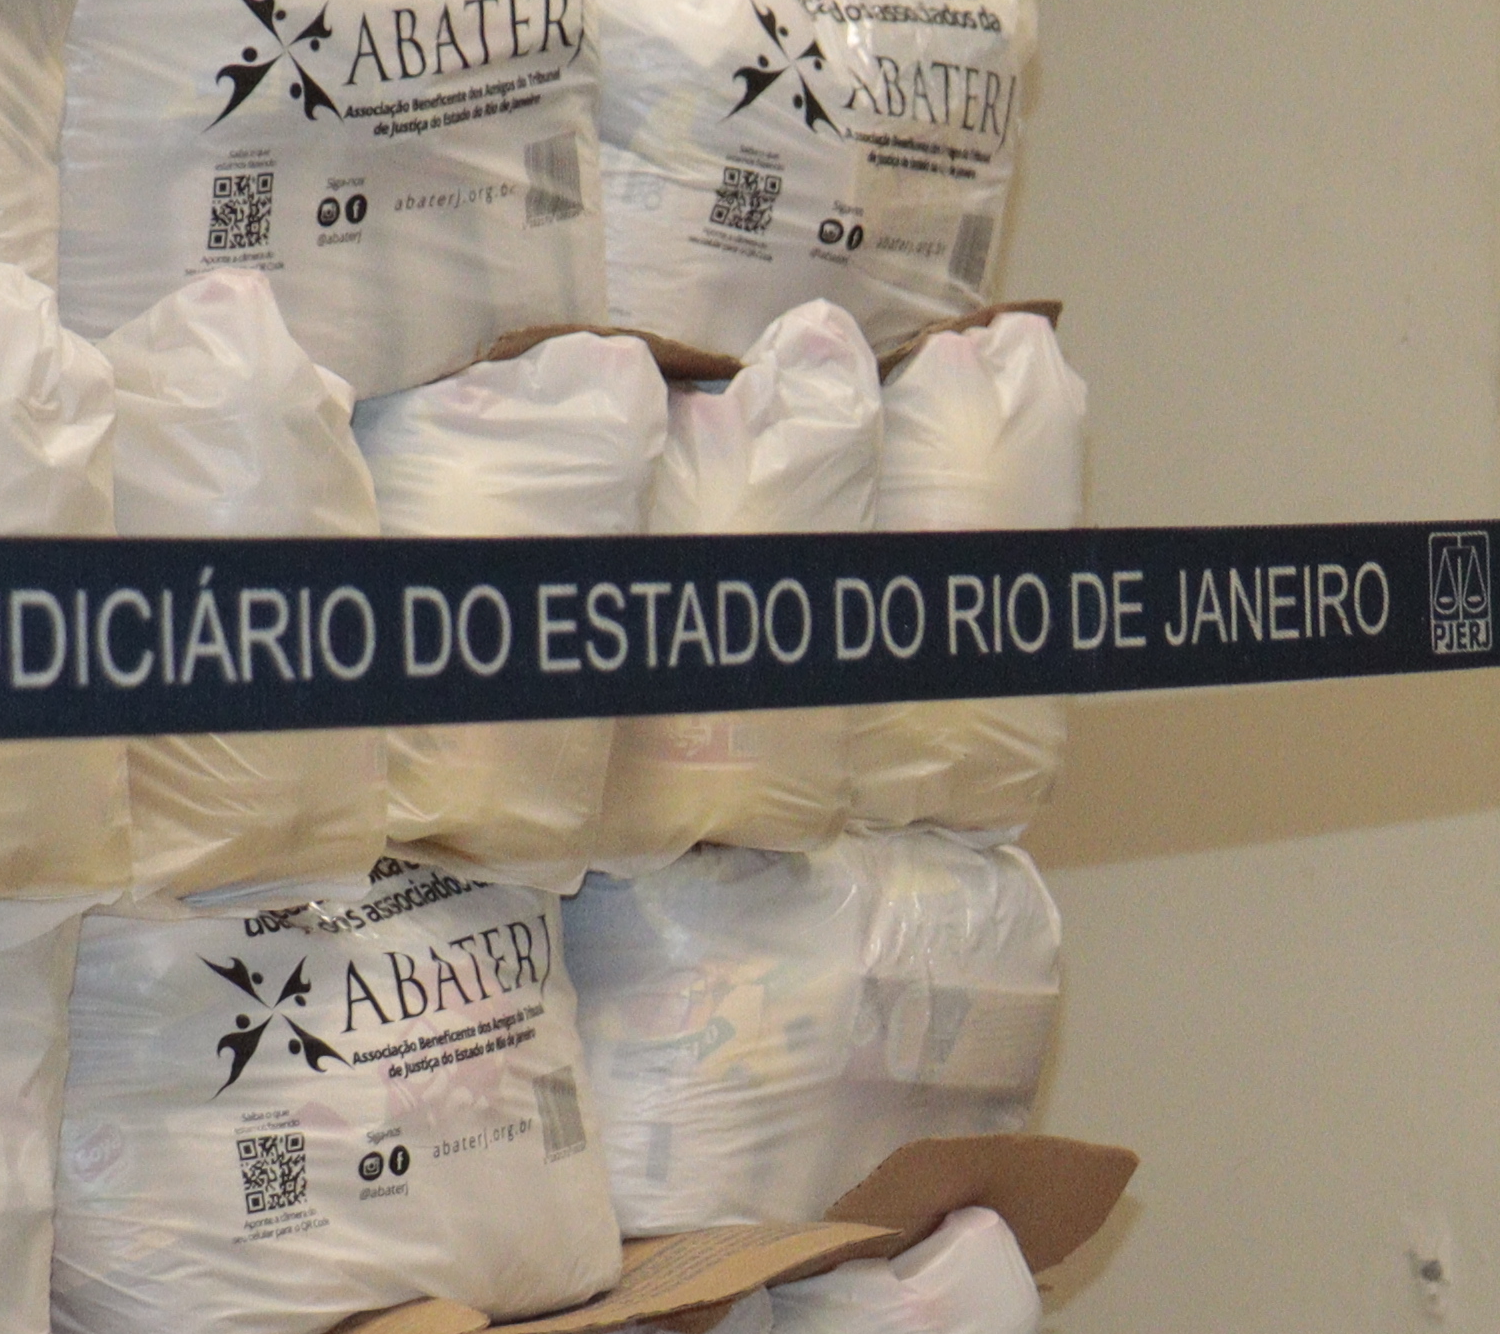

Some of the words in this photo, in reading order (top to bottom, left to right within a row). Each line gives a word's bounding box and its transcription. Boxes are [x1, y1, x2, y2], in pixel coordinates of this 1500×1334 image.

[343, 98, 410, 118] Associação
[413, 87, 467, 113] Beneficente
[468, 85, 484, 100] dos
[484, 79, 516, 100] Amigos
[516, 77, 527, 90] do
[527, 68, 561, 87] Tribunal
[373, 121, 390, 135] de
[389, 118, 429, 139] Justiça
[403, 585, 511, 678] DO
[538, 578, 812, 672] ESTADO
[835, 575, 925, 661] DO
[948, 572, 1050, 656] RIO
[1072, 571, 1148, 650] DE
[1164, 561, 1391, 647] JANEIRO
[340, 914, 552, 1034] ABATERJ
[352, 1038, 418, 1066] Associação
[418, 1027, 477, 1051] Beneficente
[477, 1022, 492, 1037] dos
[388, 1063, 402, 1079] de
[403, 1053, 440, 1079] Justiça
[441, 1051, 454, 1066] do
[455, 1042, 484, 1063] Estado
[432, 1118, 533, 1159] abaterj.org.br
[358, 1184, 409, 1201] @abaterj
